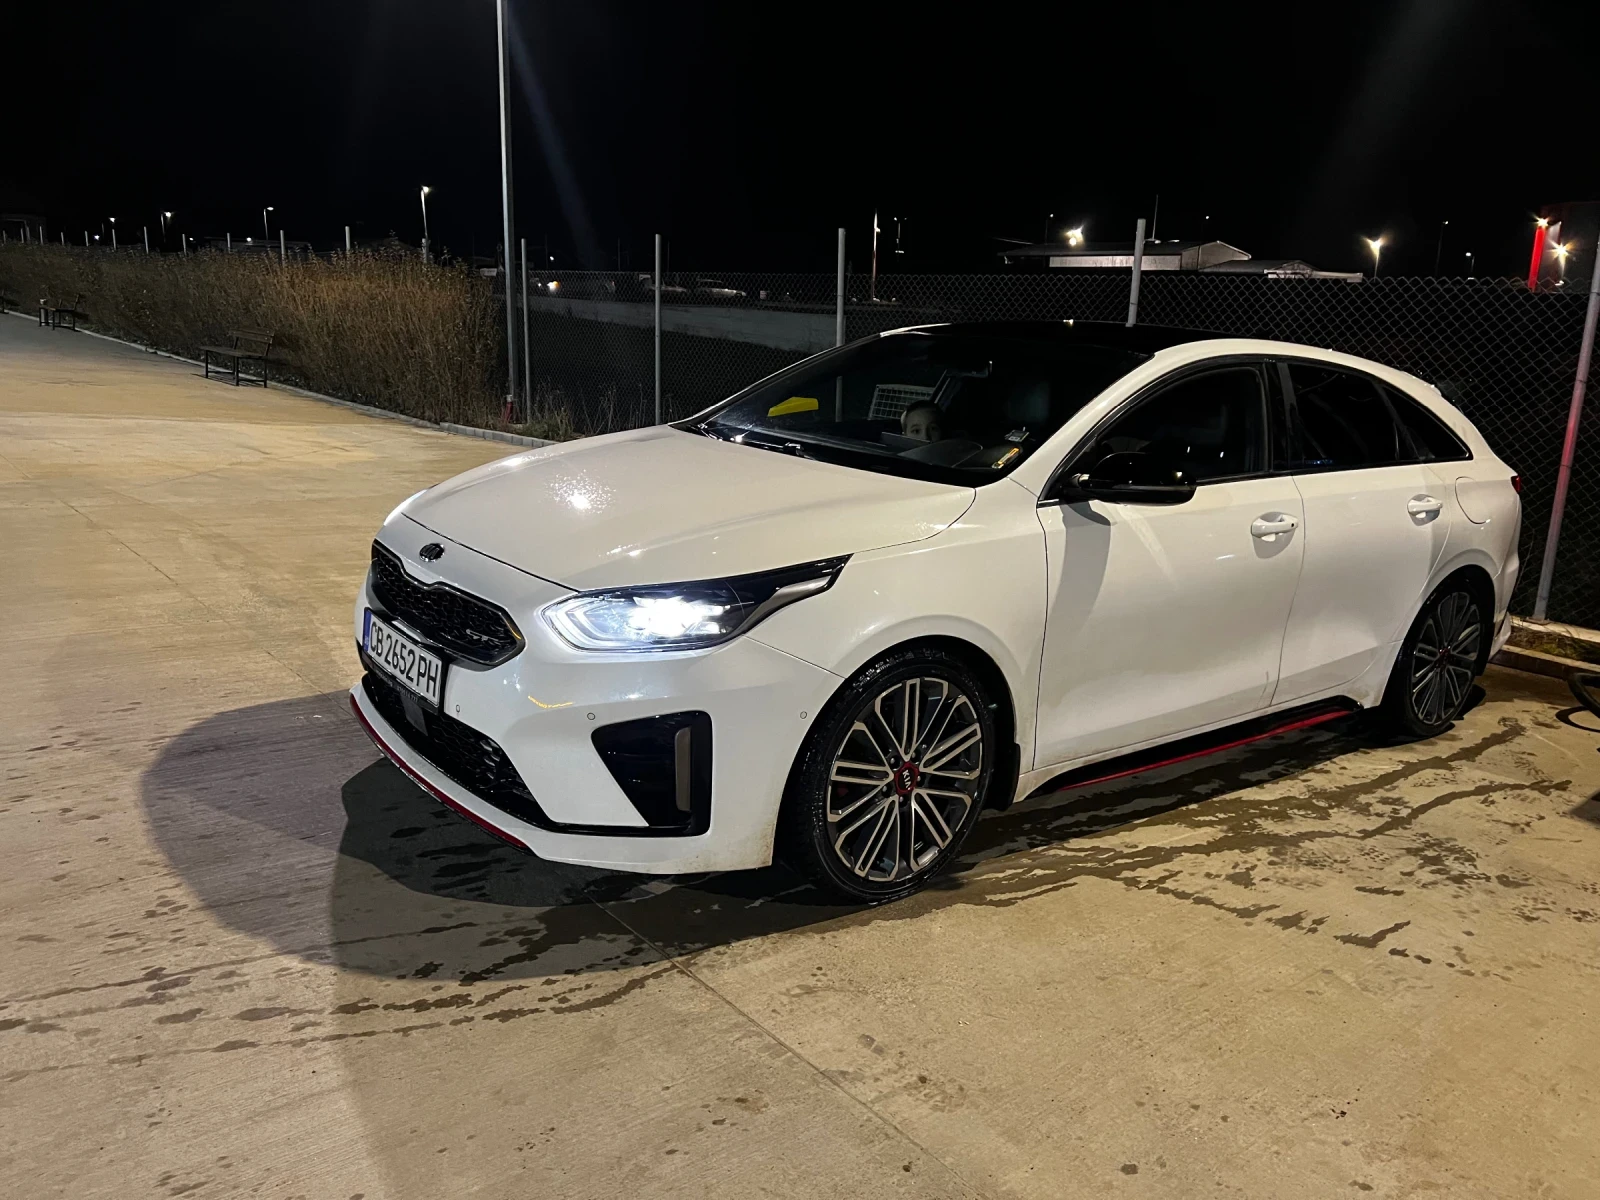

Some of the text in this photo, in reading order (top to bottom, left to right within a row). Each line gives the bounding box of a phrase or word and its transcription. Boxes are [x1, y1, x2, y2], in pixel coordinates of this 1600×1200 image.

[371, 621, 384, 657] CB
[384, 633, 416, 683] 2652
[416, 652, 439, 698] PH
[902, 769, 912, 789] KIA
